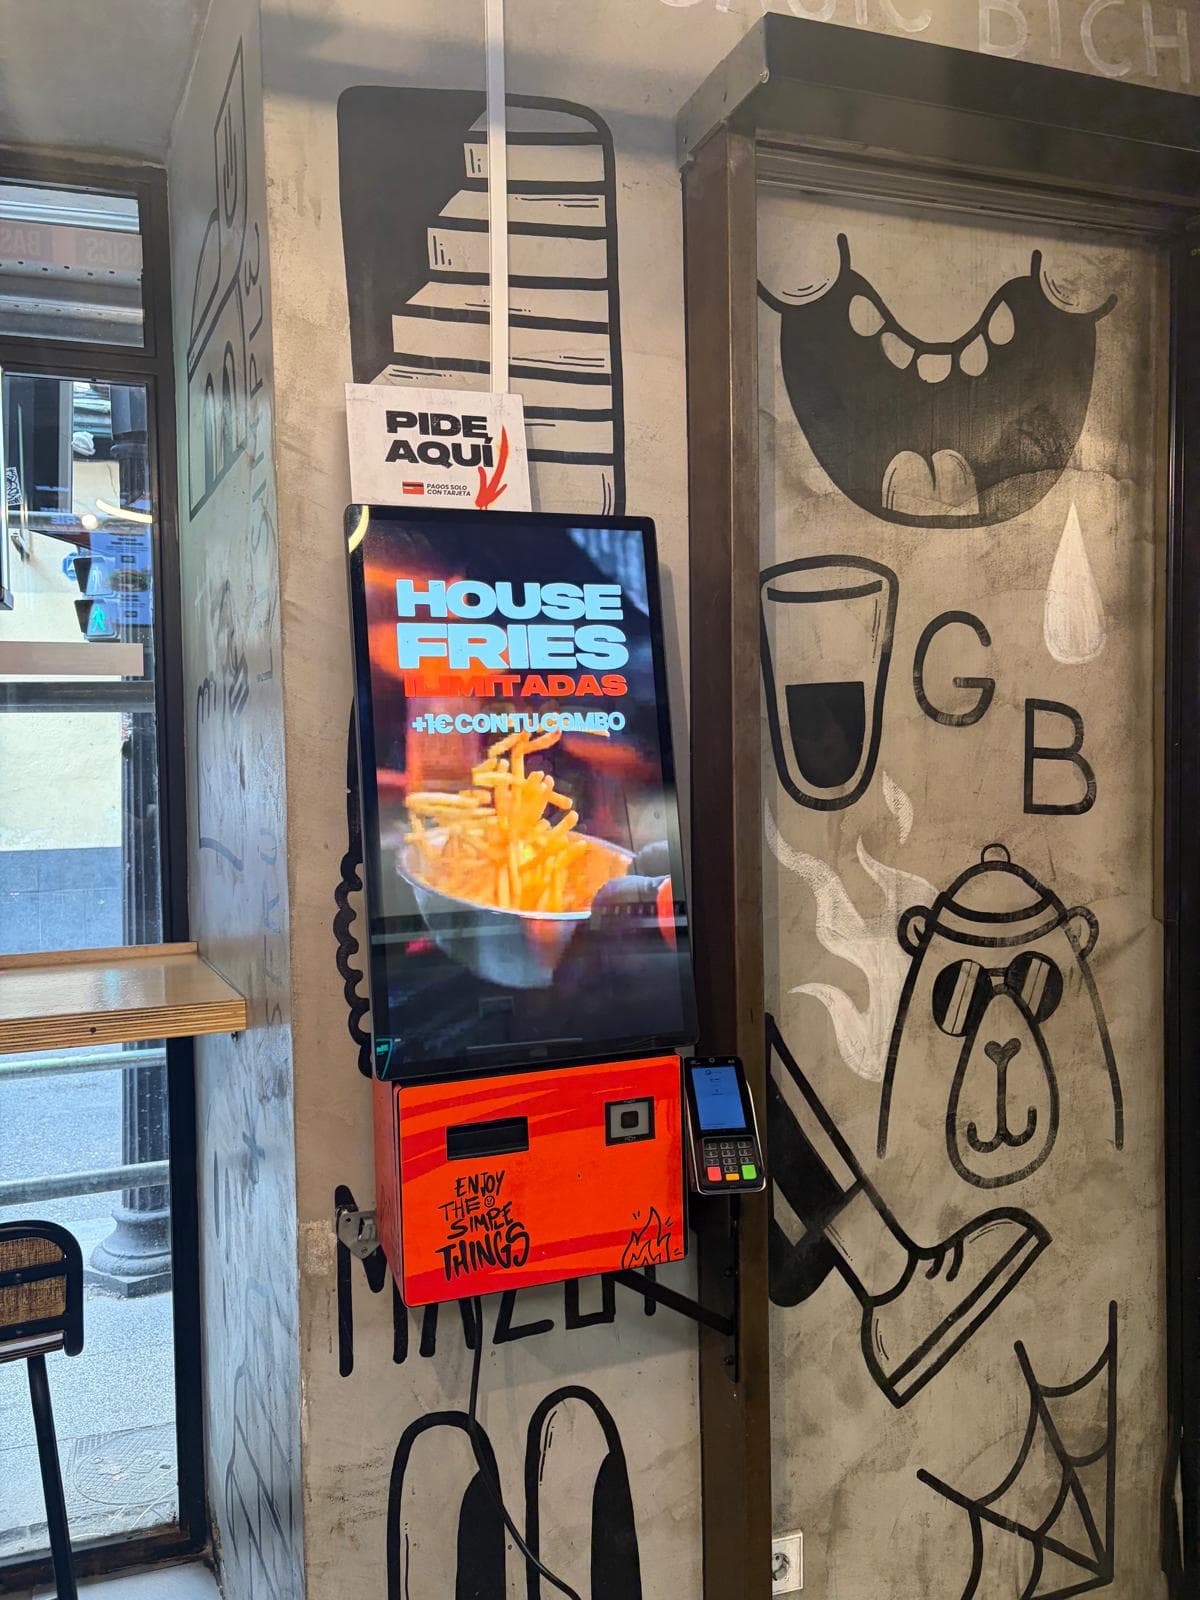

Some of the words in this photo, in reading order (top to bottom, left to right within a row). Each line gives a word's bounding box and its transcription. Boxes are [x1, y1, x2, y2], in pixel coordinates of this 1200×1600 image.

[385, 410, 489, 439] PIDE
[385, 436, 494, 469] AQUÍ
[395, 579, 624, 621] HOUSE
[396, 622, 629, 670] FRIES
[403, 674, 628, 697] ILIMITADAS
[454, 713, 508, 734] CON
[507, 713, 539, 733] TU
[541, 711, 626, 732] COMBO
[912, 610, 996, 727] G
[1023, 697, 1097, 815] B
[455, 1170, 505, 1197] ENJOY
[437, 1196, 481, 1221] THE
[447, 1201, 513, 1239] SIMPLE
[435, 1222, 530, 1281] THINGS
